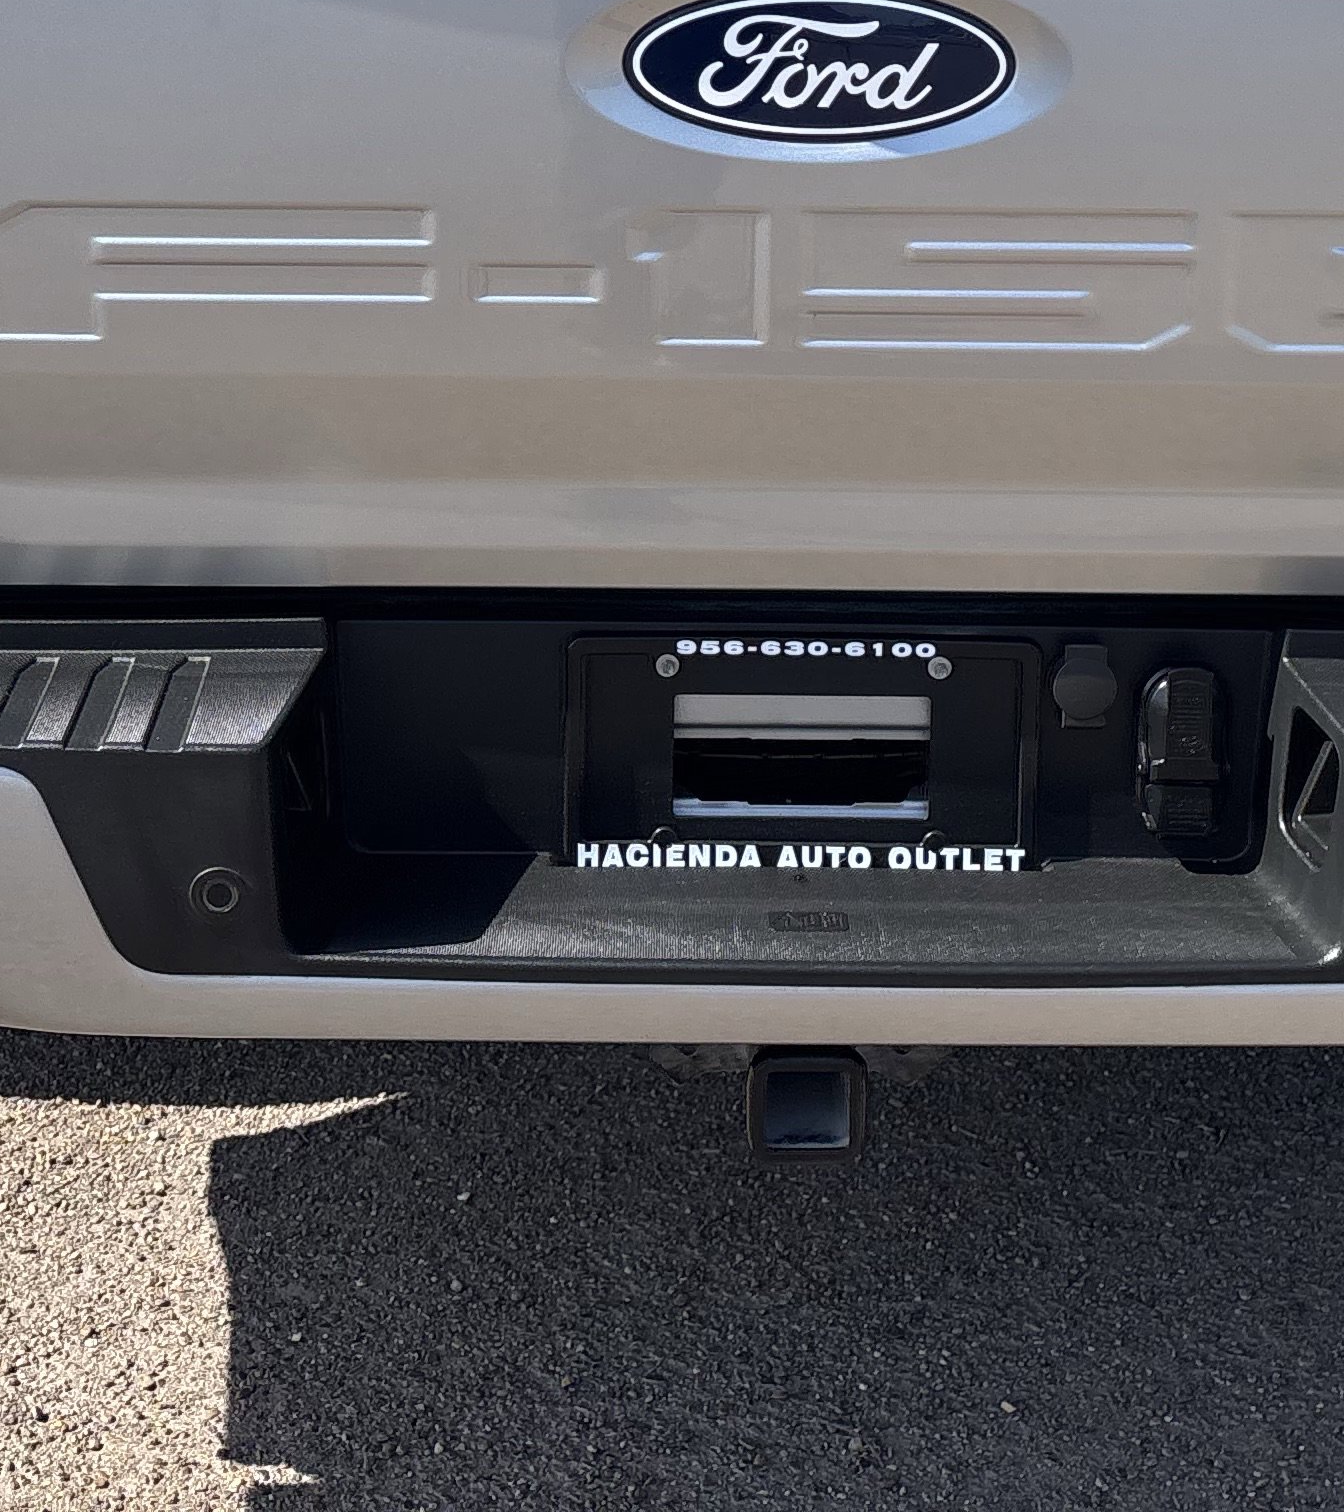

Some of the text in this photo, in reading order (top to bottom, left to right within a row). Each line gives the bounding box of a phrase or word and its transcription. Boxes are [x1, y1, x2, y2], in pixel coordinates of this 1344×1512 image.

[698, 14, 940, 110] Ford
[675, 639, 937, 658] 956-630-6100
[576, 842, 1026, 872] HACIENDA AUTO OUTLET
